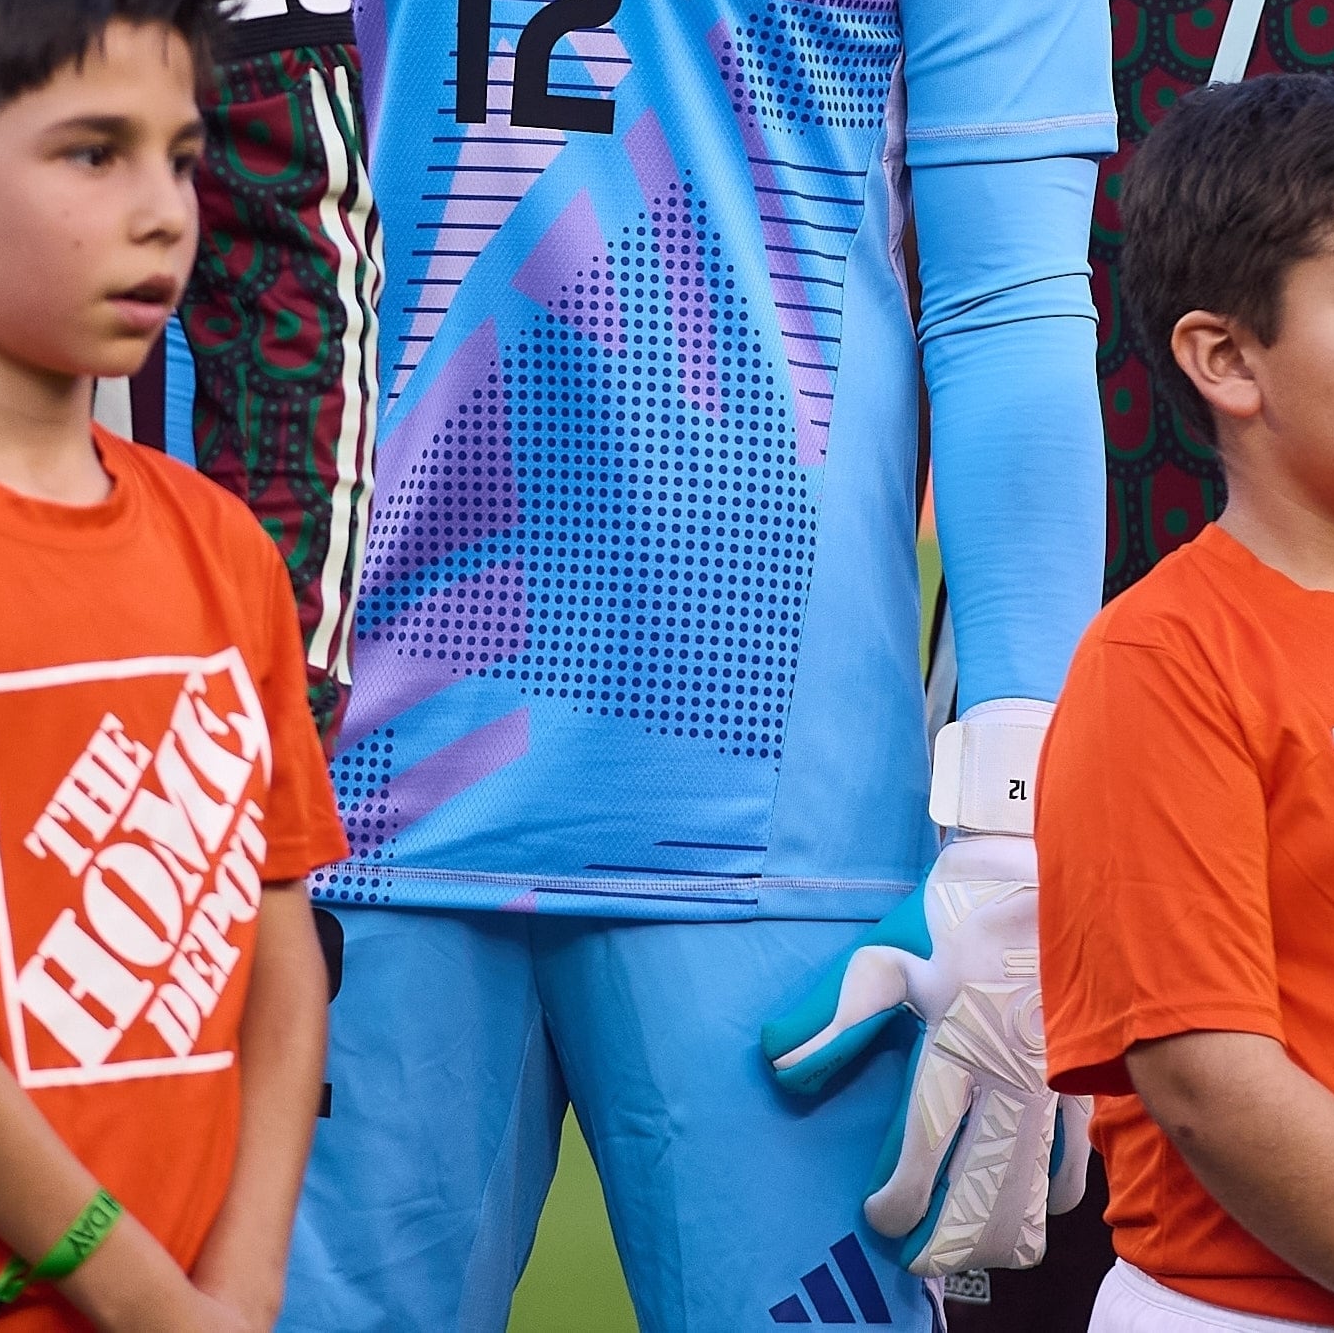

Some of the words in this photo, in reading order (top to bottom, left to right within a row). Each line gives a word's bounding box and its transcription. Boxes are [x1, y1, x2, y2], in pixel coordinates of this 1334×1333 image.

[17, 668, 262, 1066] HOME
[23, 712, 154, 878] THE
[144, 798, 268, 1057] DEPOT
